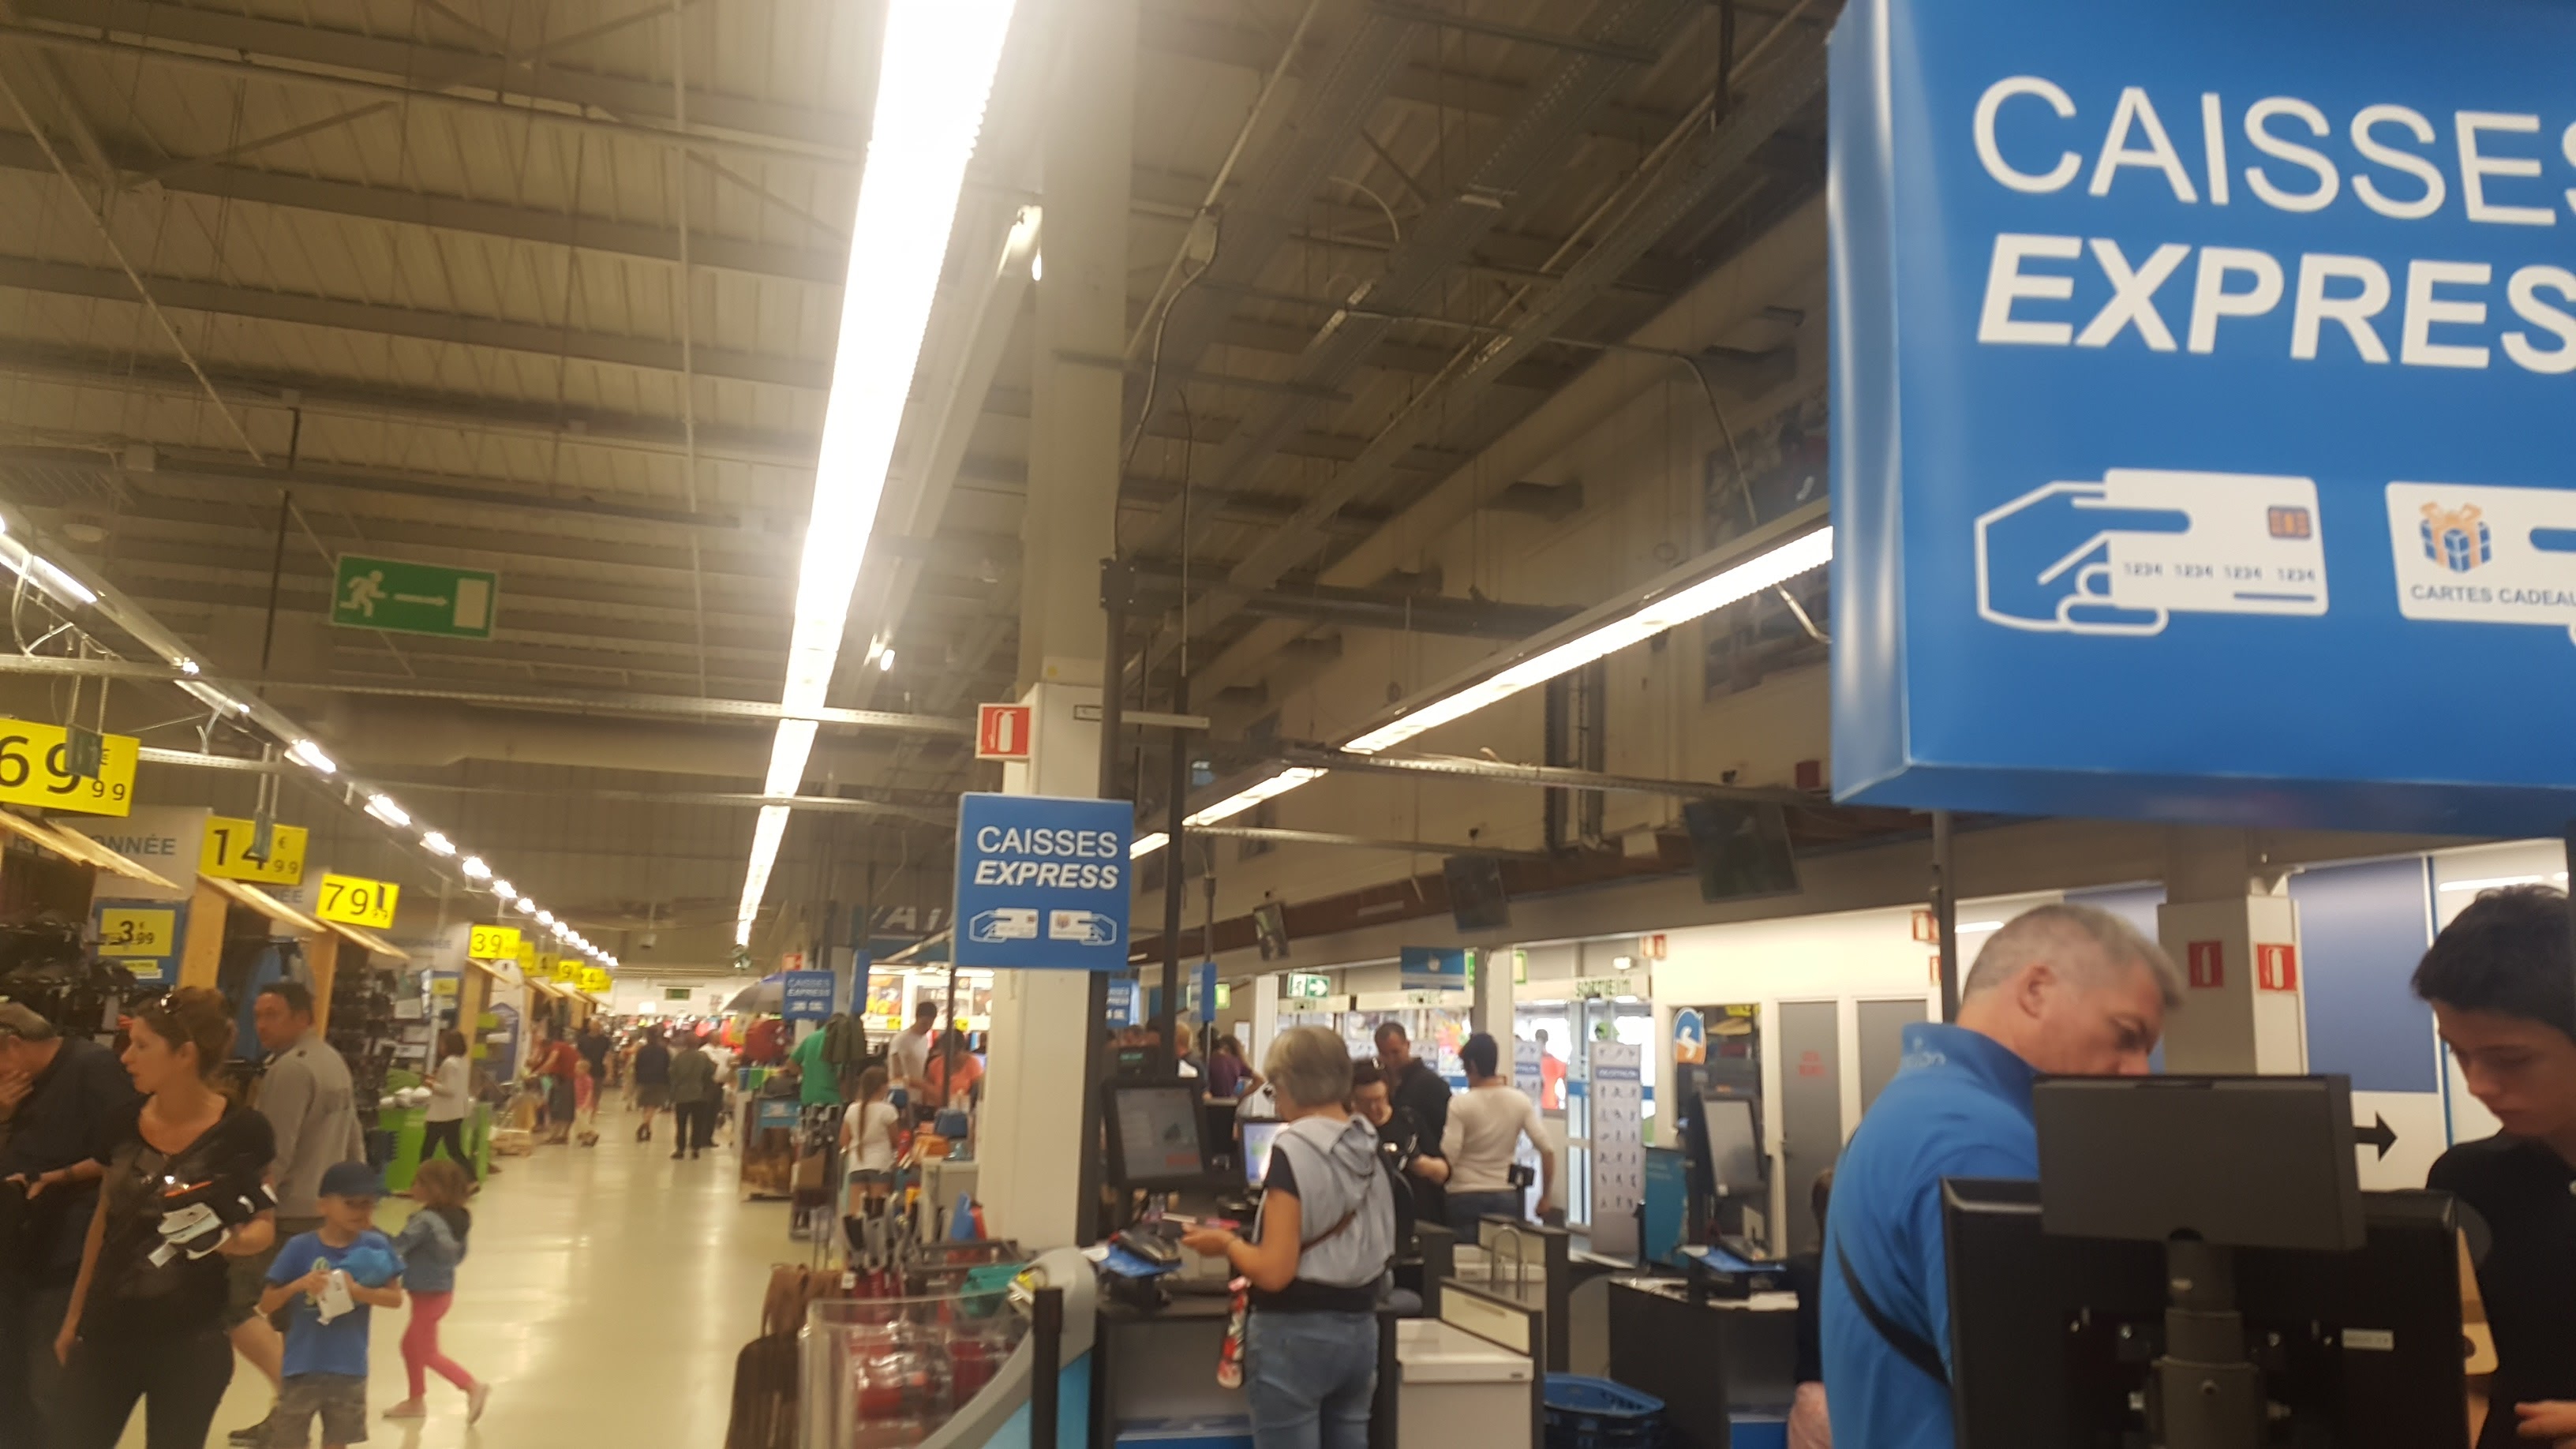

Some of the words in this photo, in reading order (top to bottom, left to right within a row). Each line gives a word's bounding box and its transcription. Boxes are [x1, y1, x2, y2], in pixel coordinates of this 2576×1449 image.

[1972, 75, 2576, 226] CAISSE
[2410, 583, 2492, 603] CARTES
[92, 780, 125, 800] 99
[976, 826, 1118, 859] CAISSES
[974, 859, 1120, 890] EXPRESS
[325, 882, 368, 915] 79
[472, 933, 501, 956] 39
